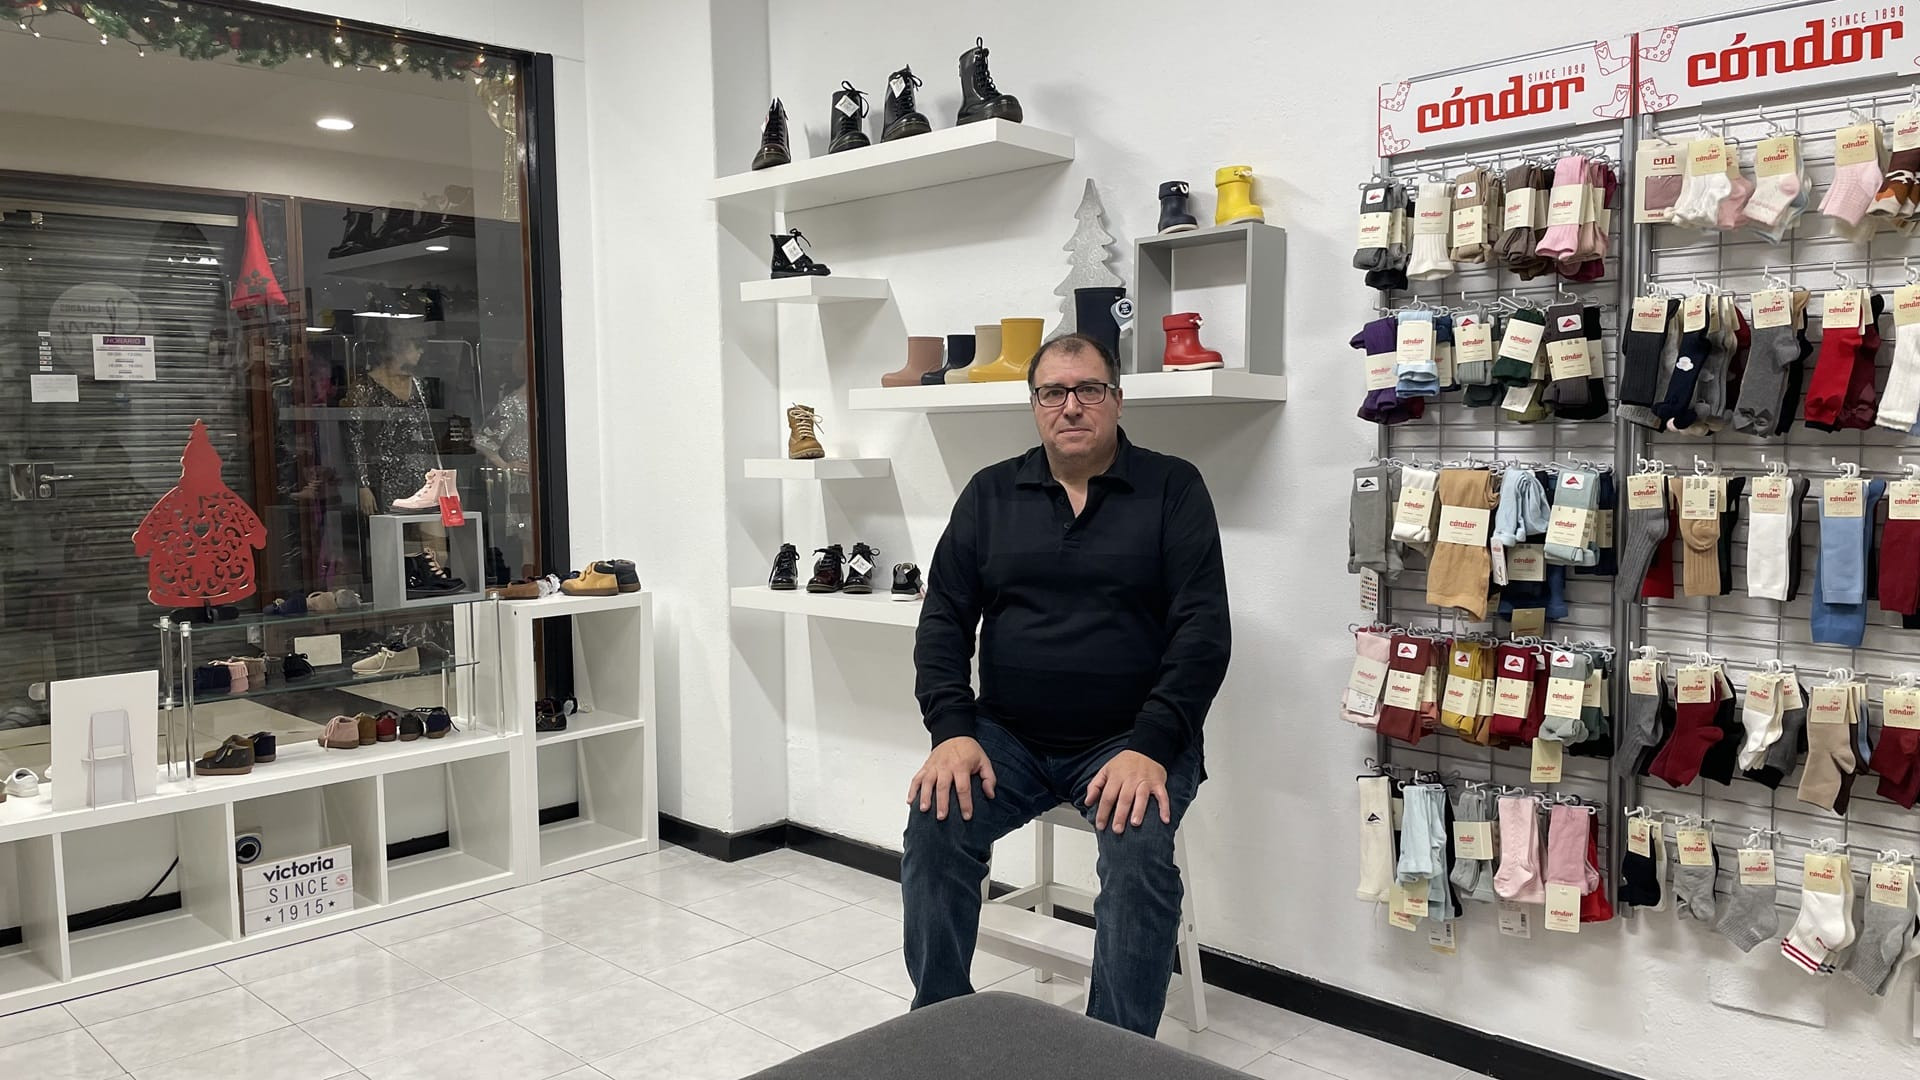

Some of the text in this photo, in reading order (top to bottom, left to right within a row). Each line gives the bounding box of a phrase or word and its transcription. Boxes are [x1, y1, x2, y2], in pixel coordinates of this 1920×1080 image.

[1831, 5, 1904, 28] SINCE 1898
[1687, 19, 1903, 87] cóndor
[1528, 63, 1585, 82] SINCE 1898
[1417, 75, 1585, 133] cóndor
[1653, 155, 1675, 166] cnd
[263, 856, 334, 882] victoria
[269, 876, 329, 904] SINCE
[278, 899, 324, 923] 1915
